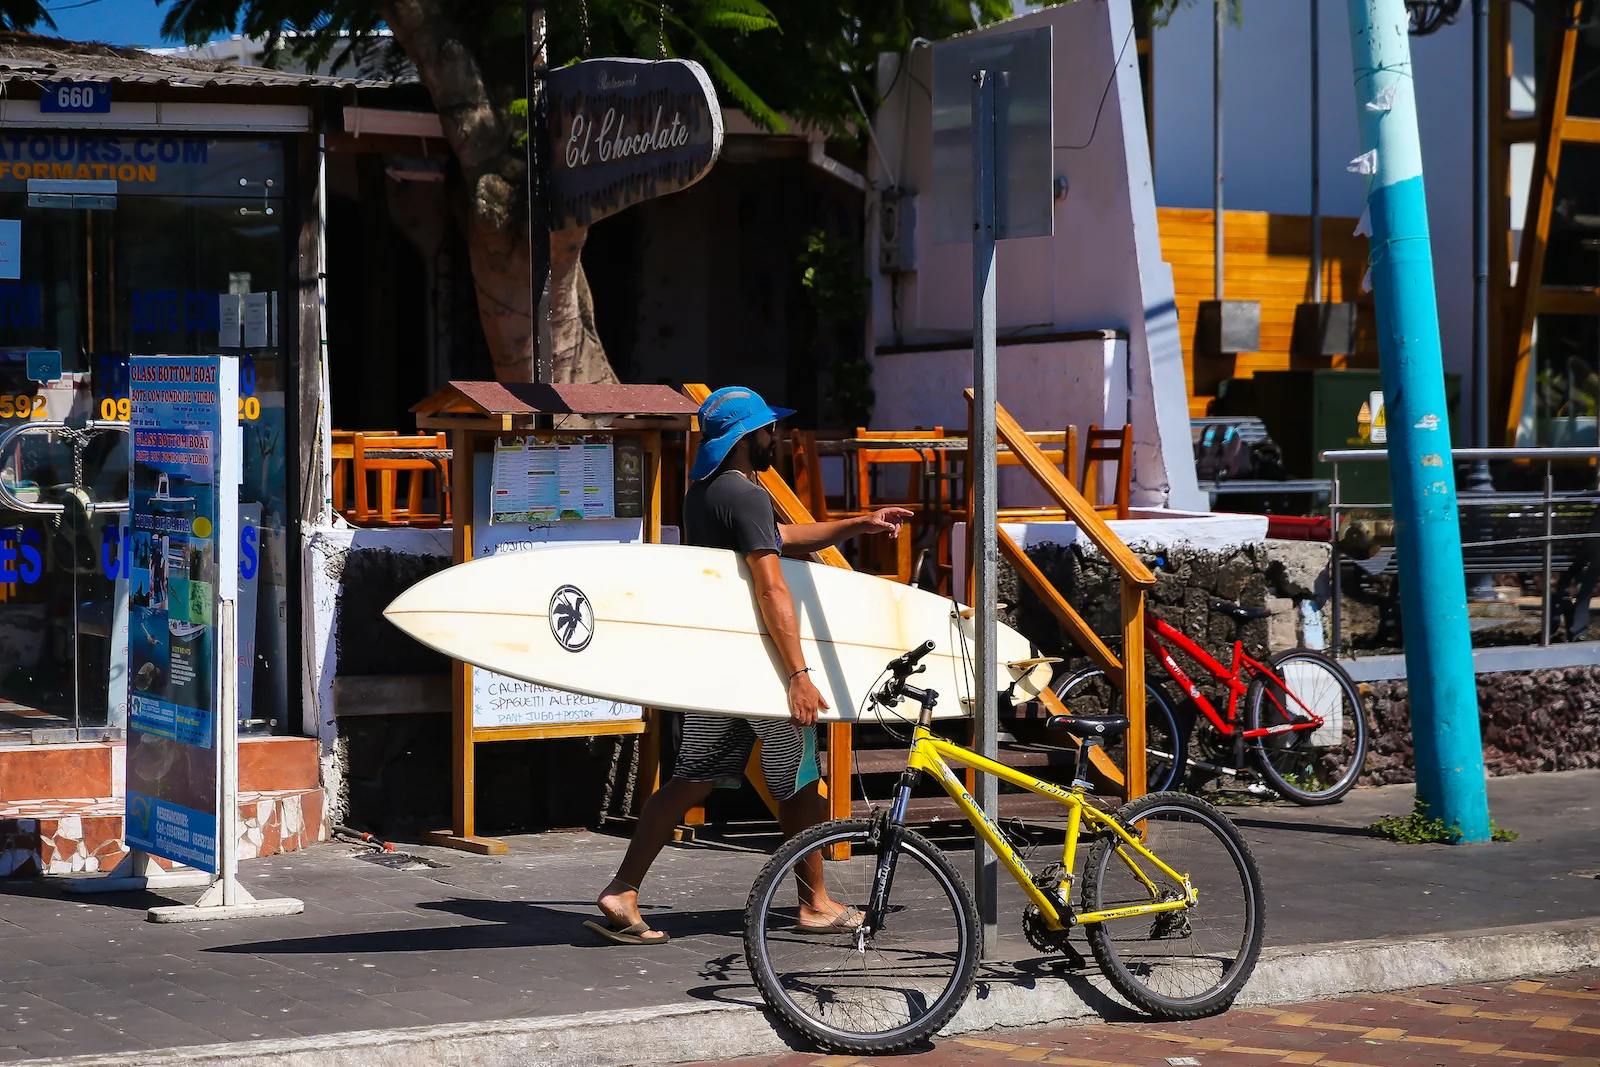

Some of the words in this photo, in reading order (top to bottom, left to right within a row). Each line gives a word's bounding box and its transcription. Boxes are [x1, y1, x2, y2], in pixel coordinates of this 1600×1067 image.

[58, 87, 93, 107] 660
[565, 114, 592, 168] El
[595, 105, 689, 162] Chocolate
[131, 290, 179, 333] BOTE
[131, 366, 156, 382] GLASS
[158, 366, 192, 383] BOTTOM
[194, 366, 216, 383] BOAT
[131, 390, 146, 402] BOTE
[148, 390, 160, 402] CON
[161, 390, 182, 403] FONDO
[183, 391, 192, 403] DE
[193, 391, 216, 404] VIDRIO
[0, 395, 47, 419] 592
[135, 432, 157, 446] GLASS
[158, 432, 188, 448] BOTTOM
[189, 434, 210, 449] BOAT
[136, 450, 149, 461] BOTE
[150, 451, 160, 462] CON
[161, 451, 179, 463] FONDO
[180, 452, 188, 463] DE
[188, 453, 209, 465] VIDRIO
[135, 514, 154, 530] TOUR
[155, 516, 165, 530] DE
[494, 541, 533, 553] MOJITO
[0, 528, 42, 584] ES
[489, 696, 544, 711] SPAGUETTI
[1034, 779, 1072, 799] Team
